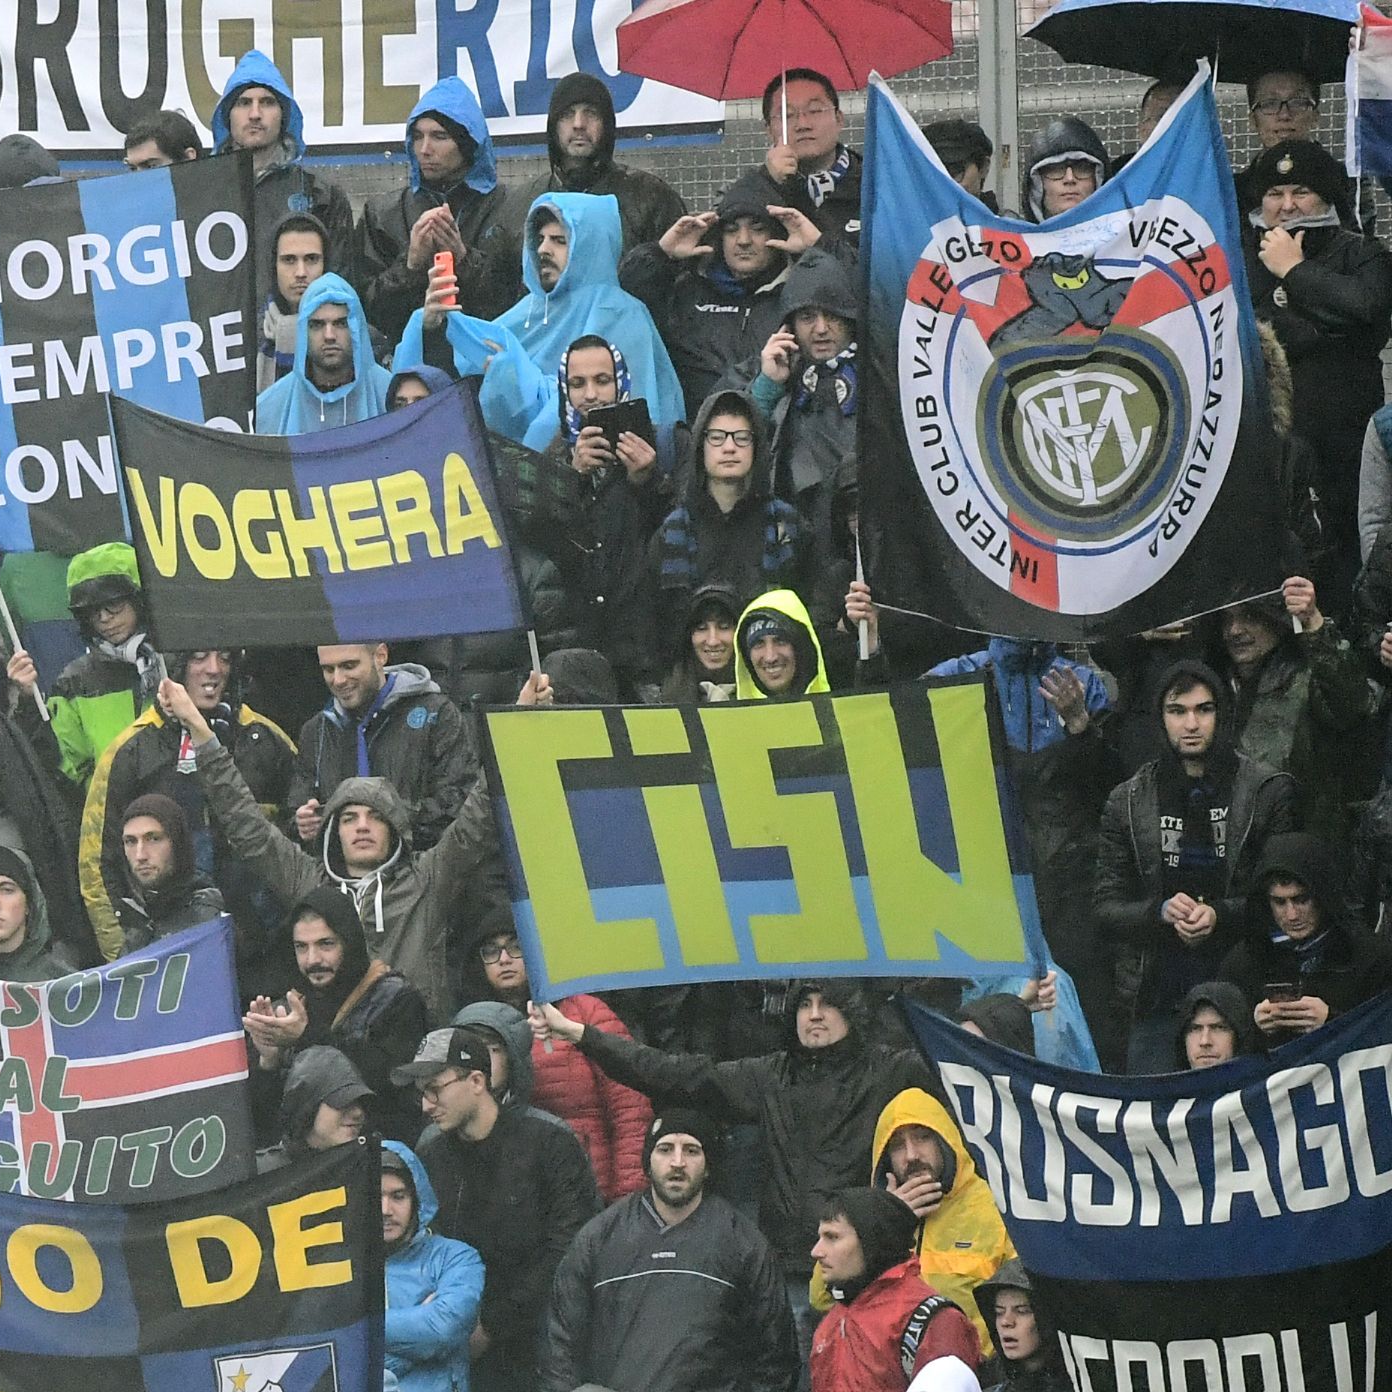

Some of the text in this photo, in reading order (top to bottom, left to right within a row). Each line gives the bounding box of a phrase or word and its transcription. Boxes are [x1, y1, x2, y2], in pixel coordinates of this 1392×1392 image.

[915, 394, 961, 498] CLUB
[123, 451, 503, 580] VOGHERA
[165, 1185, 355, 1309] DE
